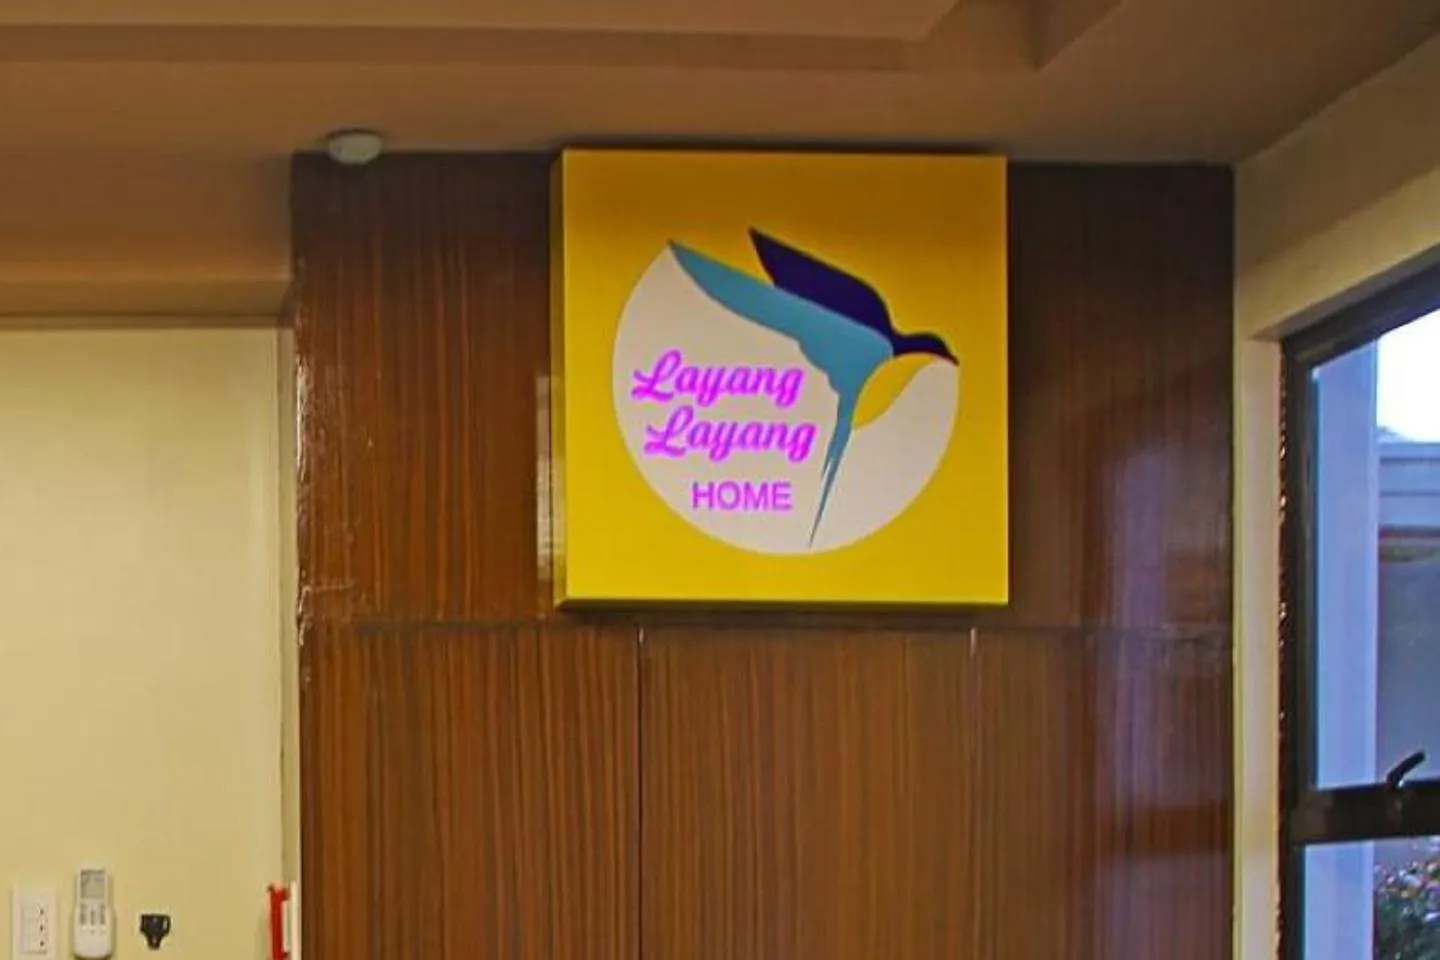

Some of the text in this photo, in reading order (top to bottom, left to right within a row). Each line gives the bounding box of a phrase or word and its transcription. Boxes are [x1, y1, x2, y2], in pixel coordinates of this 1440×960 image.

[631, 349, 804, 407] Layang
[643, 405, 816, 462] Layang
[691, 481, 792, 511] HOME
